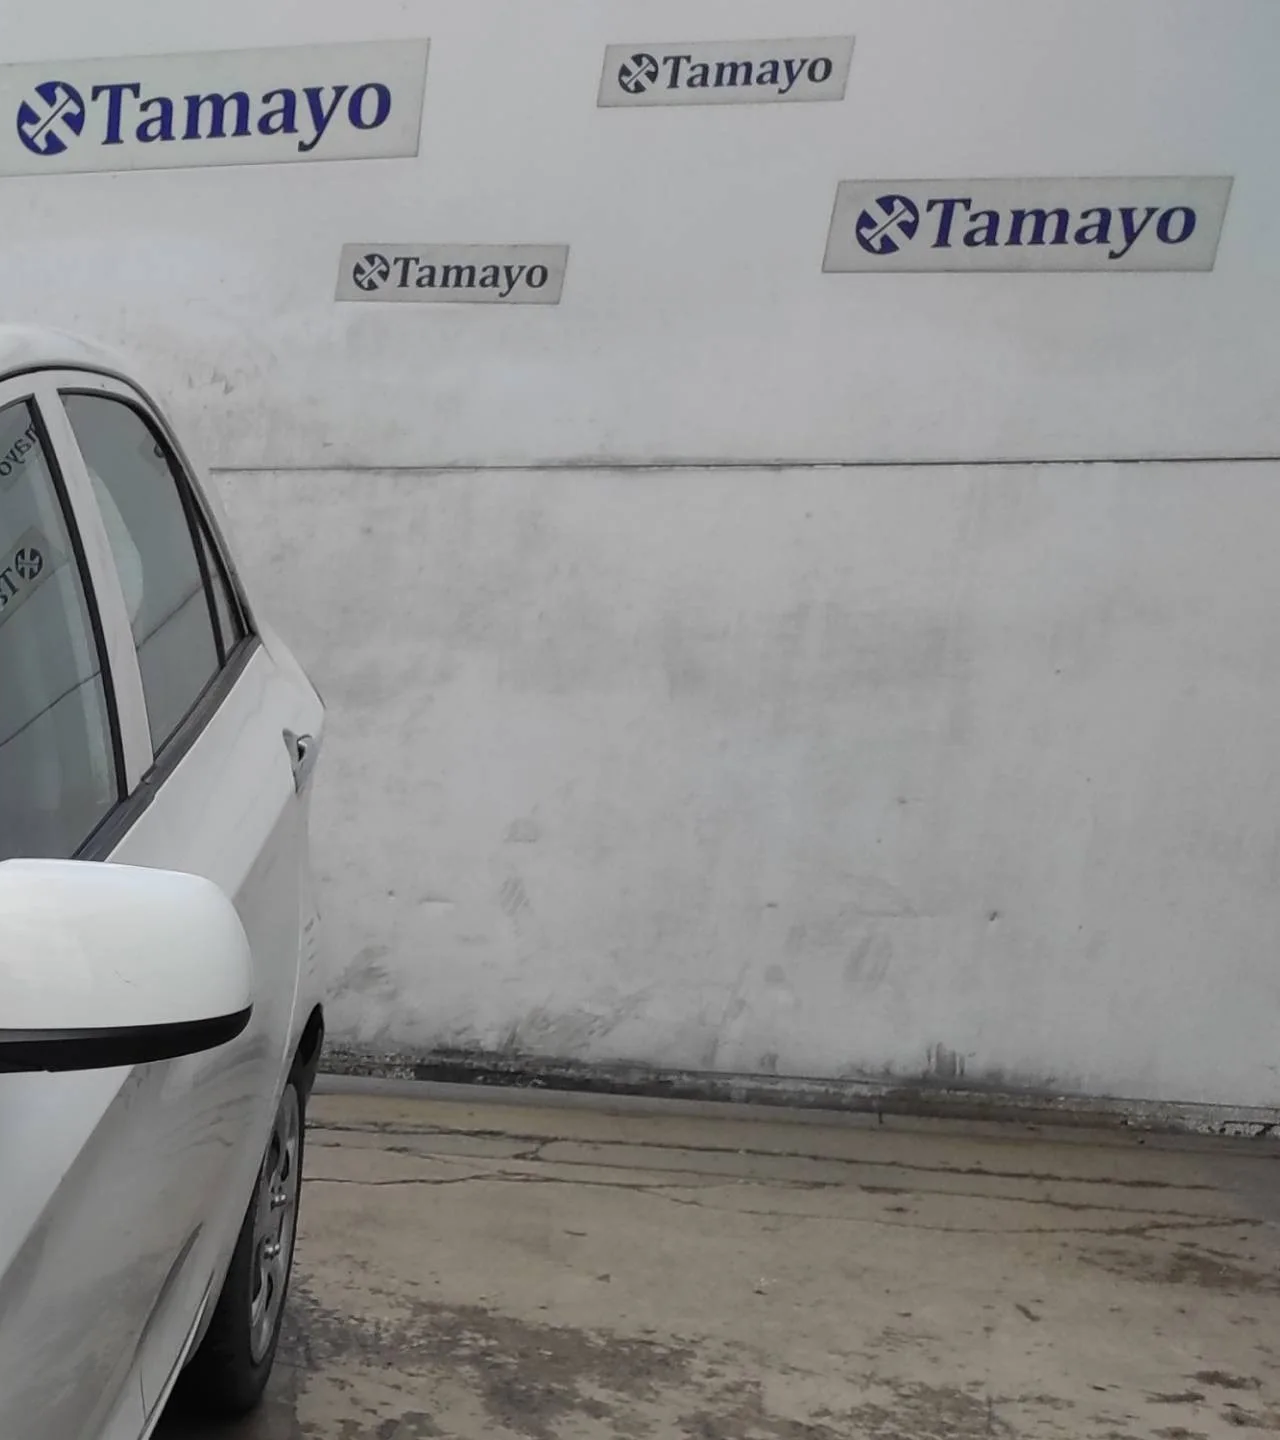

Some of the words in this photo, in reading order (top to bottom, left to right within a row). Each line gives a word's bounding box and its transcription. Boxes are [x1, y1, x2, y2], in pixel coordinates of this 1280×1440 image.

[662, 54, 833, 95] Tamayo
[91, 82, 392, 152] Tamayo
[925, 197, 1197, 259] Tamayo
[393, 256, 549, 297] Tamayo
